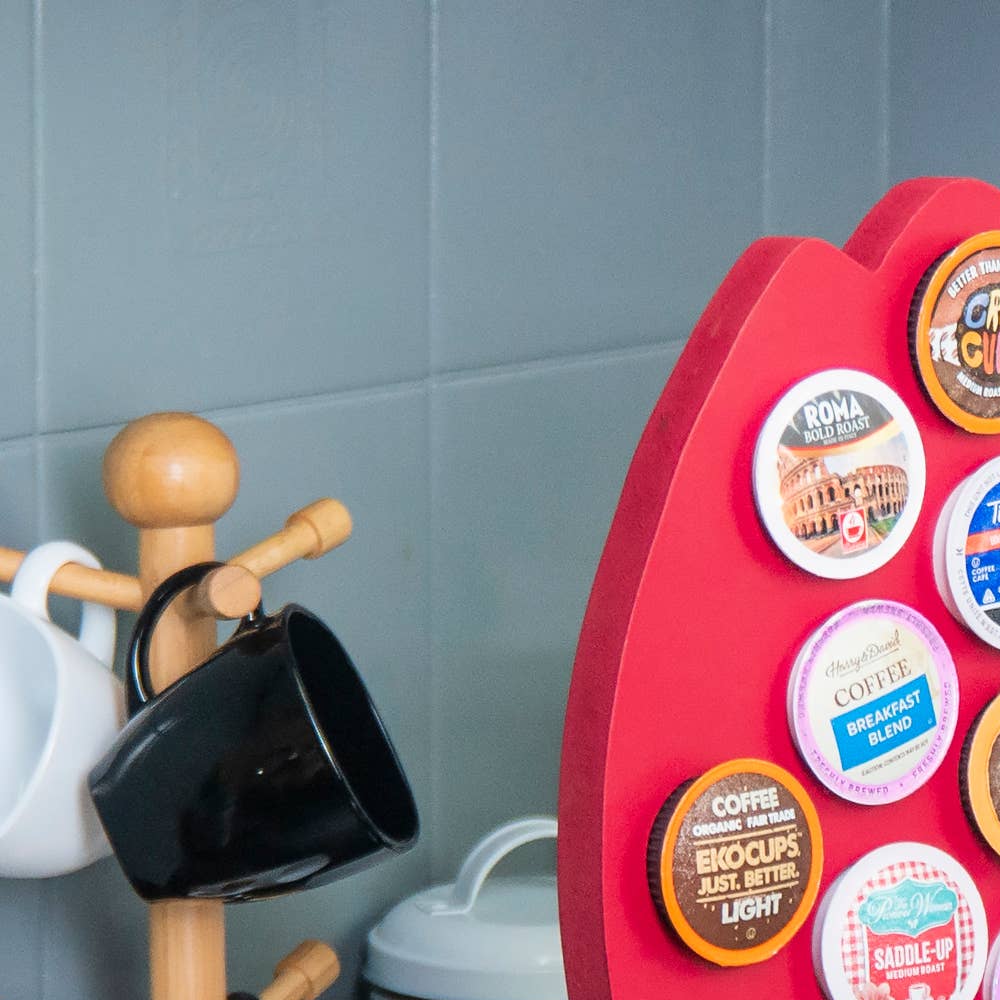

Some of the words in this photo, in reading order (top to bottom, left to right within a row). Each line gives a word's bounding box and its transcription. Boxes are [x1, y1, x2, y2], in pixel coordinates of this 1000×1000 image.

[947, 266, 978, 298] BETTER
[803, 394, 865, 429] ROMA
[804, 424, 835, 444] BOLD
[837, 415, 871, 437] ROAST
[971, 565, 995, 575] COFFEE
[834, 658, 912, 708] COFFEE
[846, 689, 921, 737] BREAKFAST
[867, 717, 912, 747] BLEND
[711, 787, 780, 818] COFFEE
[692, 818, 743, 837] ORGANIC
[747, 813, 768, 829] FAIR
[768, 808, 796, 824] TRADE
[696, 833, 801, 875] EKOCUPS
[697, 873, 741, 896] JUST.
[744, 862, 800, 889] BETTER.
[721, 892, 783, 925] LIGHT
[874, 937, 954, 971] SADDLE-UP
[886, 966, 920, 980] MEDIUM
[921, 962, 945, 975] ROAST
